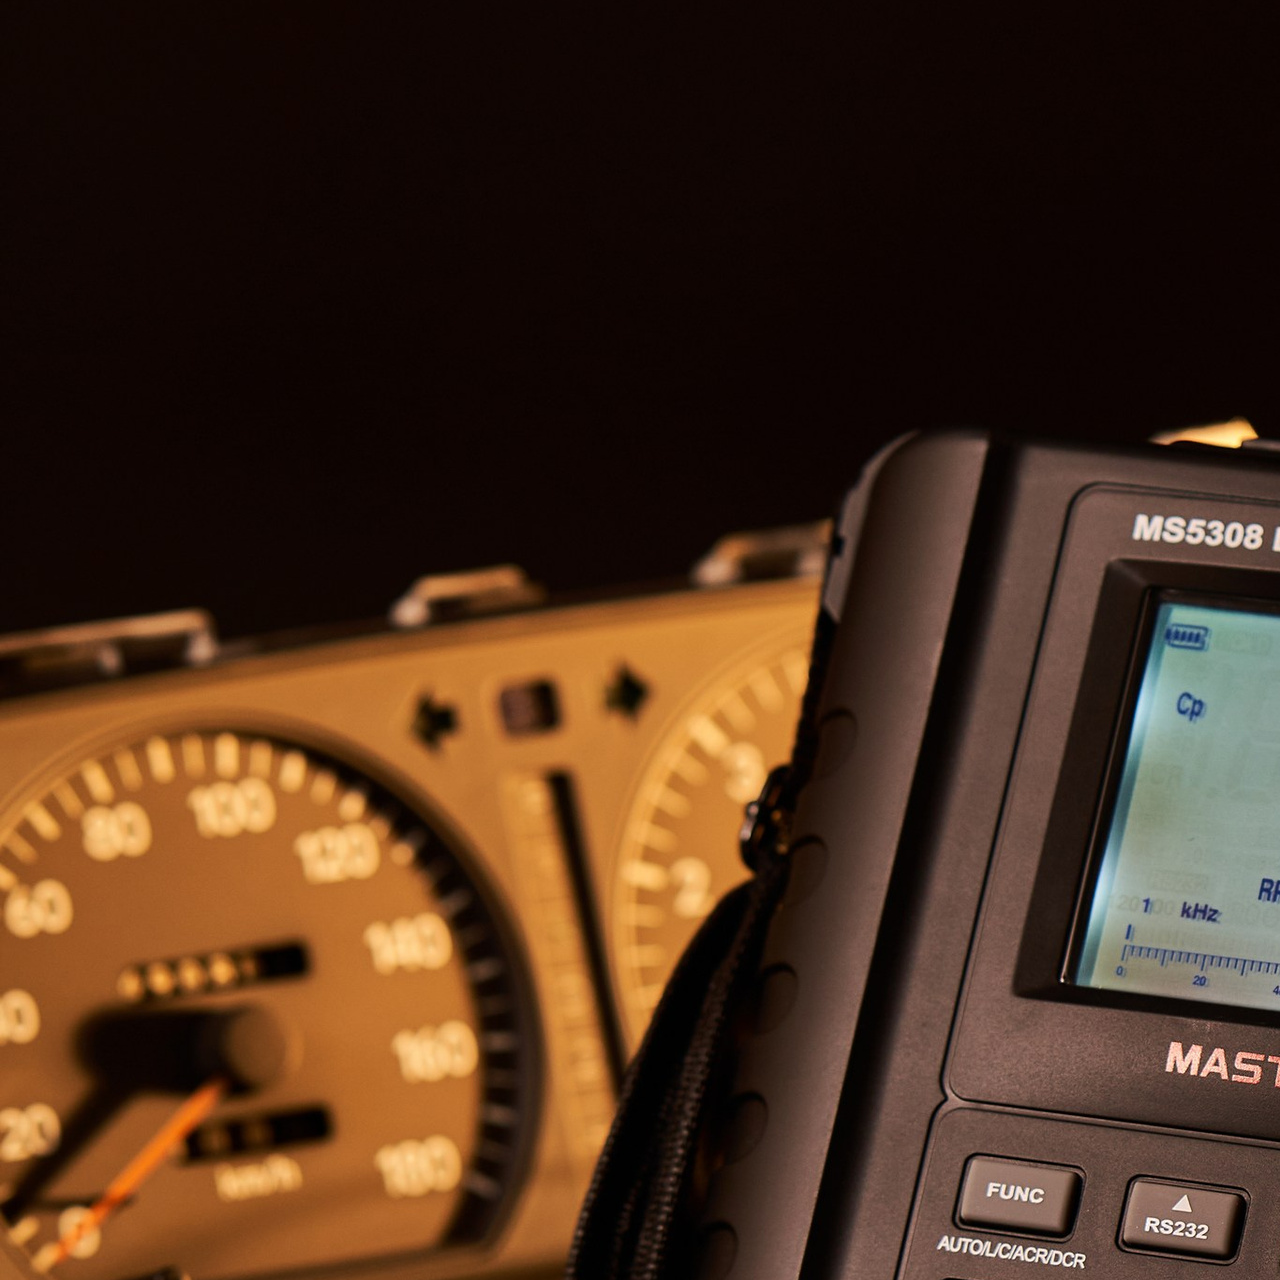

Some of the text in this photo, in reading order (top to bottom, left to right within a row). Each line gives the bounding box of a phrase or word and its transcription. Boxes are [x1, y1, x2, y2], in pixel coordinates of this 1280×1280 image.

[1132, 514, 1264, 550] MS5308
[1176, 692, 1204, 720] Cp
[189, 776, 276, 838] 100
[1180, 902, 1219, 922] kHz
[1192, 975, 1207, 987] 20
[0, 989, 40, 1045] 0
[985, 1181, 1044, 1204] FUNC
[1144, 1216, 1209, 1241] RS232
[936, 1235, 1086, 1269] AUTO/L/C/ACR/DCR
